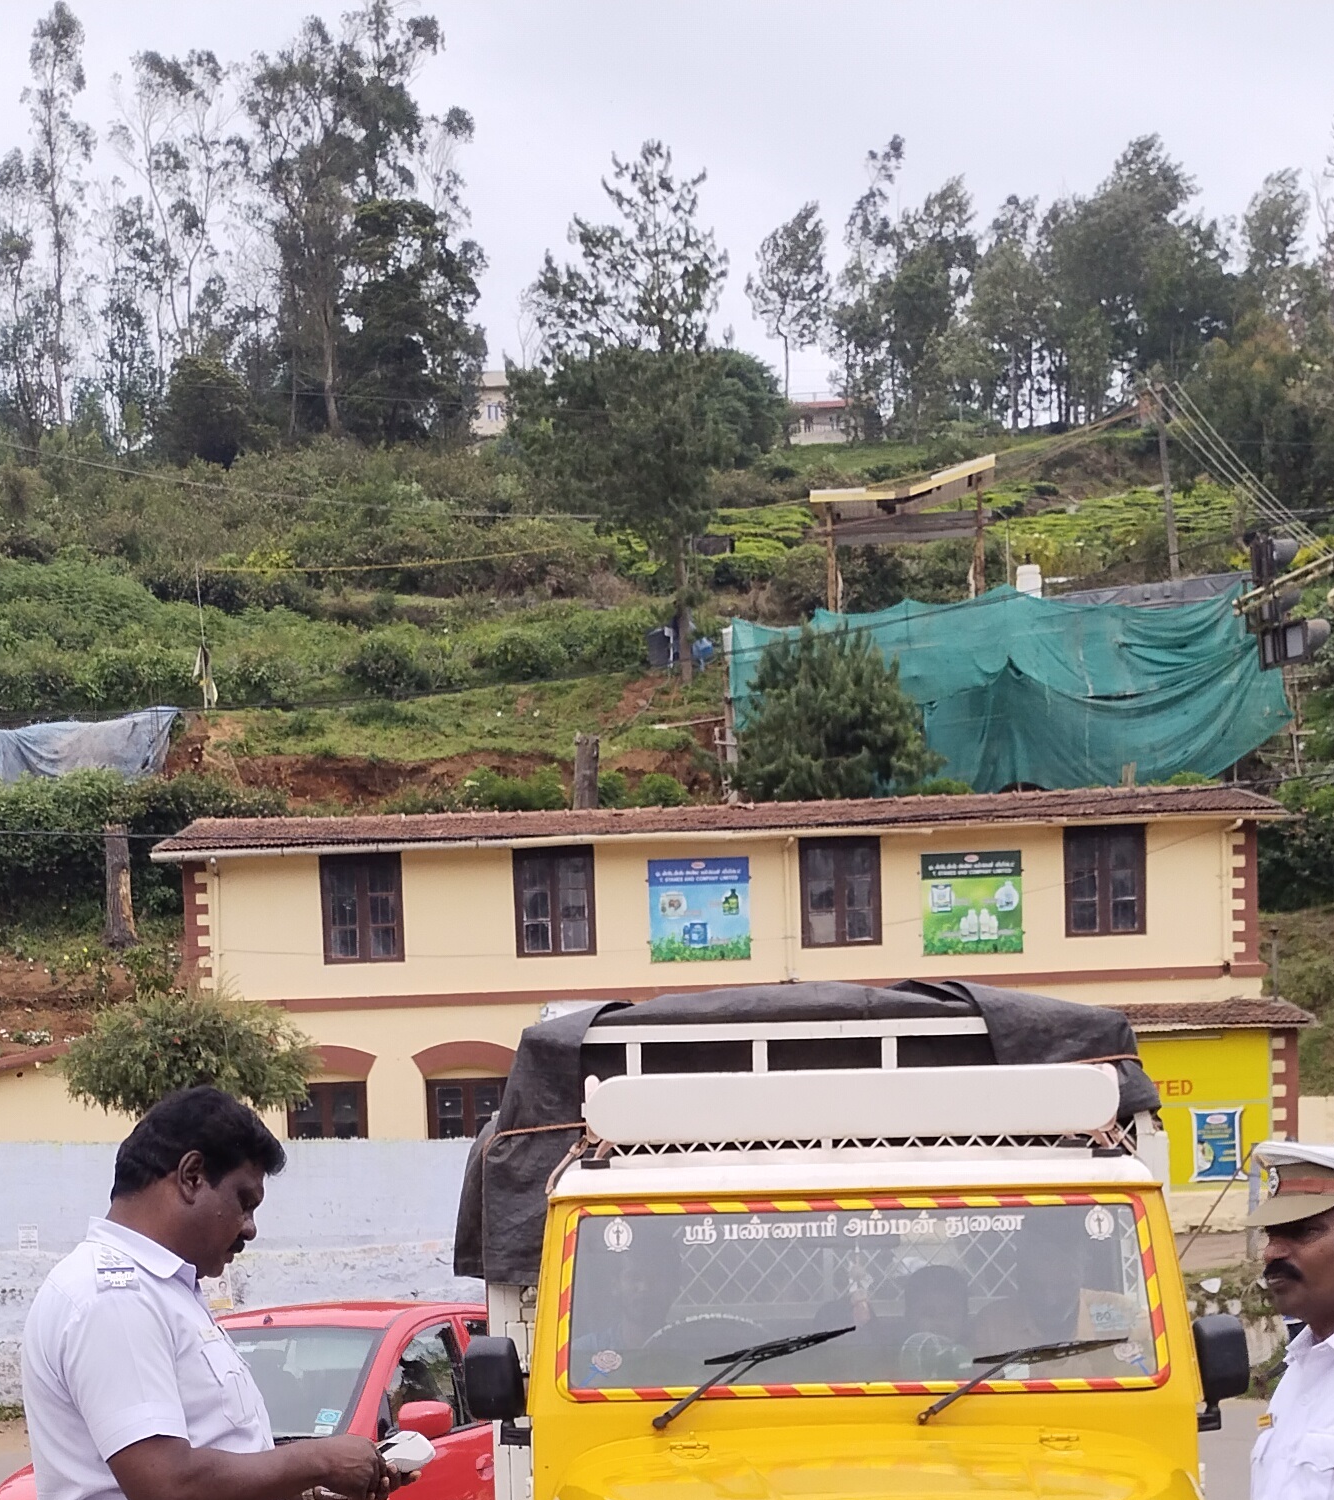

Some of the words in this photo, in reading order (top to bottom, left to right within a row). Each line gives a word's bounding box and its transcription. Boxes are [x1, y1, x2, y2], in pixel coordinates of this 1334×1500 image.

[723, 1214, 838, 1241] பண்ணாரி
[843, 1209, 937, 1238] அம்மன்
[945, 1213, 1025, 1238] துணை
